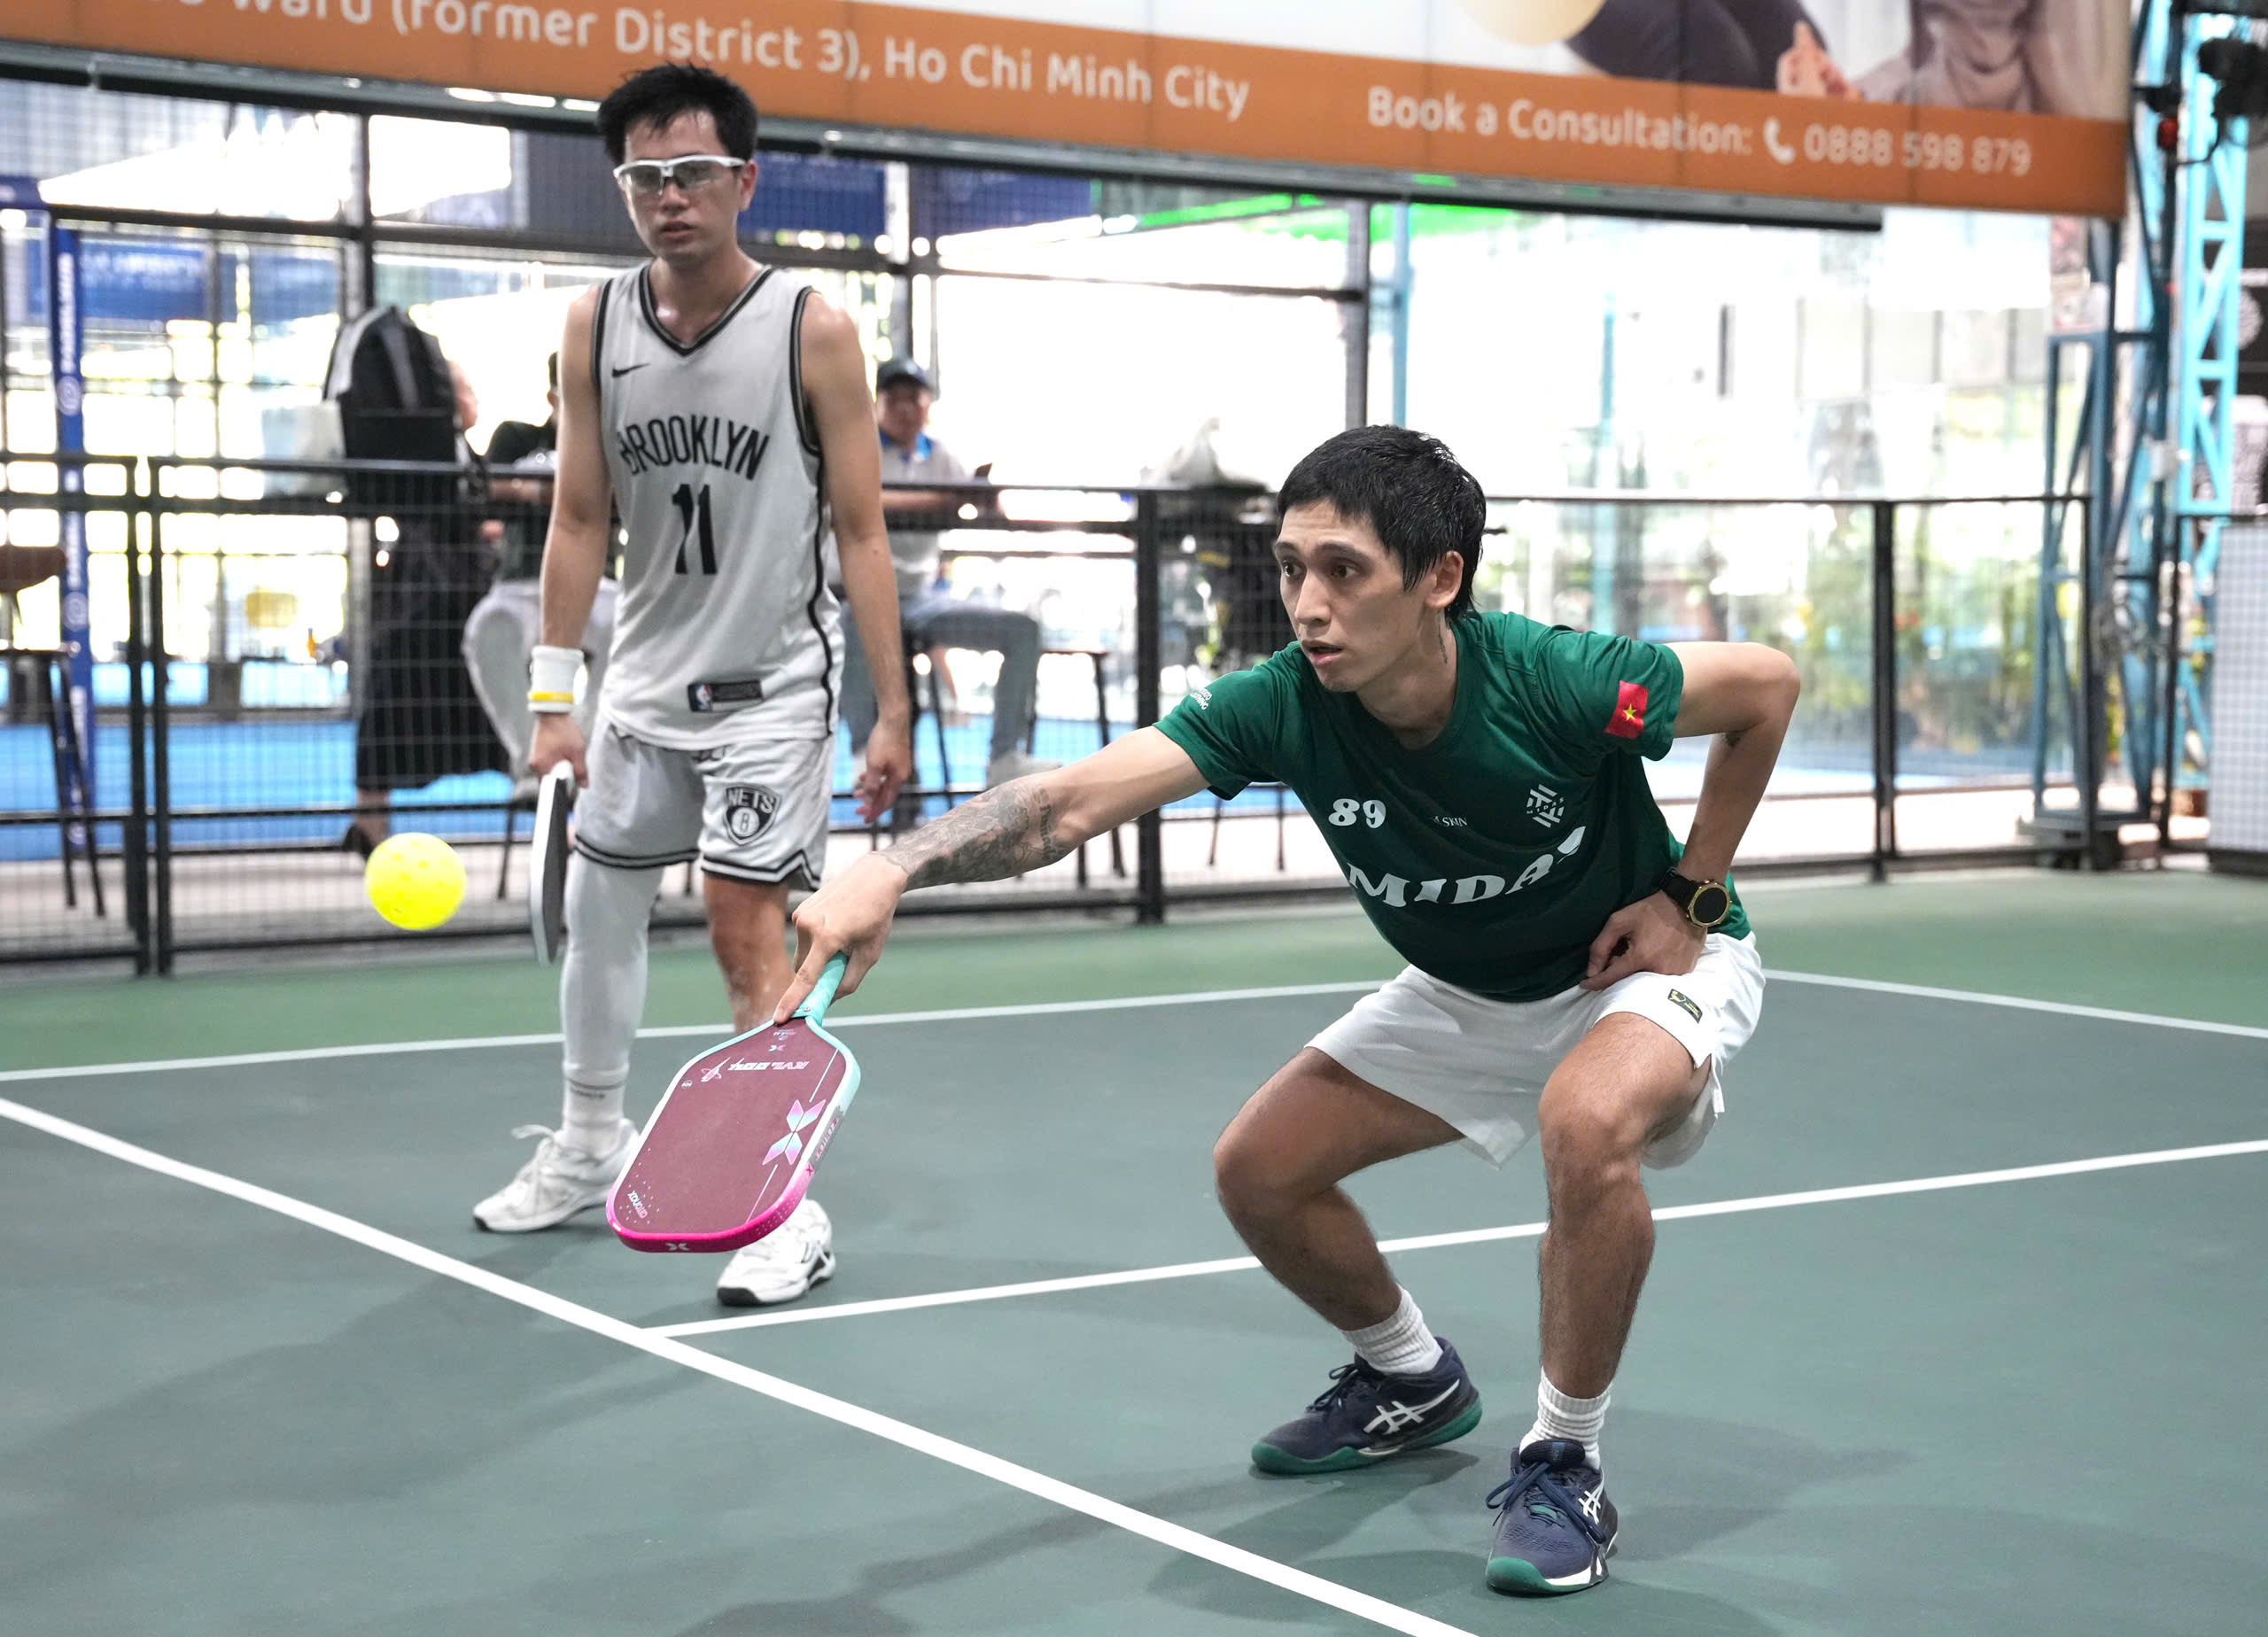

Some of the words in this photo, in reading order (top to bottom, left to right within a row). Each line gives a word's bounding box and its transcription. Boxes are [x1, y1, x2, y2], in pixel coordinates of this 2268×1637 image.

[392, 0, 598, 47] (Former
[615, 9, 802, 71] District
[817, 29, 871, 81] 3),
[884, 37, 946, 83] Ho
[960, 44, 1033, 90] Chi
[1047, 53, 1153, 103] Minh
[1164, 66, 1251, 120] City
[1367, 86, 1467, 134] Book
[1475, 103, 1498, 136] a
[1508, 98, 1753, 156] Consultation:
[1803, 122, 1894, 167] 0888
[1900, 130, 1964, 172] 598
[1970, 136, 2032, 176] 879
[617, 414, 770, 481] BROOKLYN
[672, 483, 718, 576] 11
[727, 787, 775, 814] NETS
[1328, 797, 1386, 829] 89
[1347, 826, 1587, 907] MIDA
